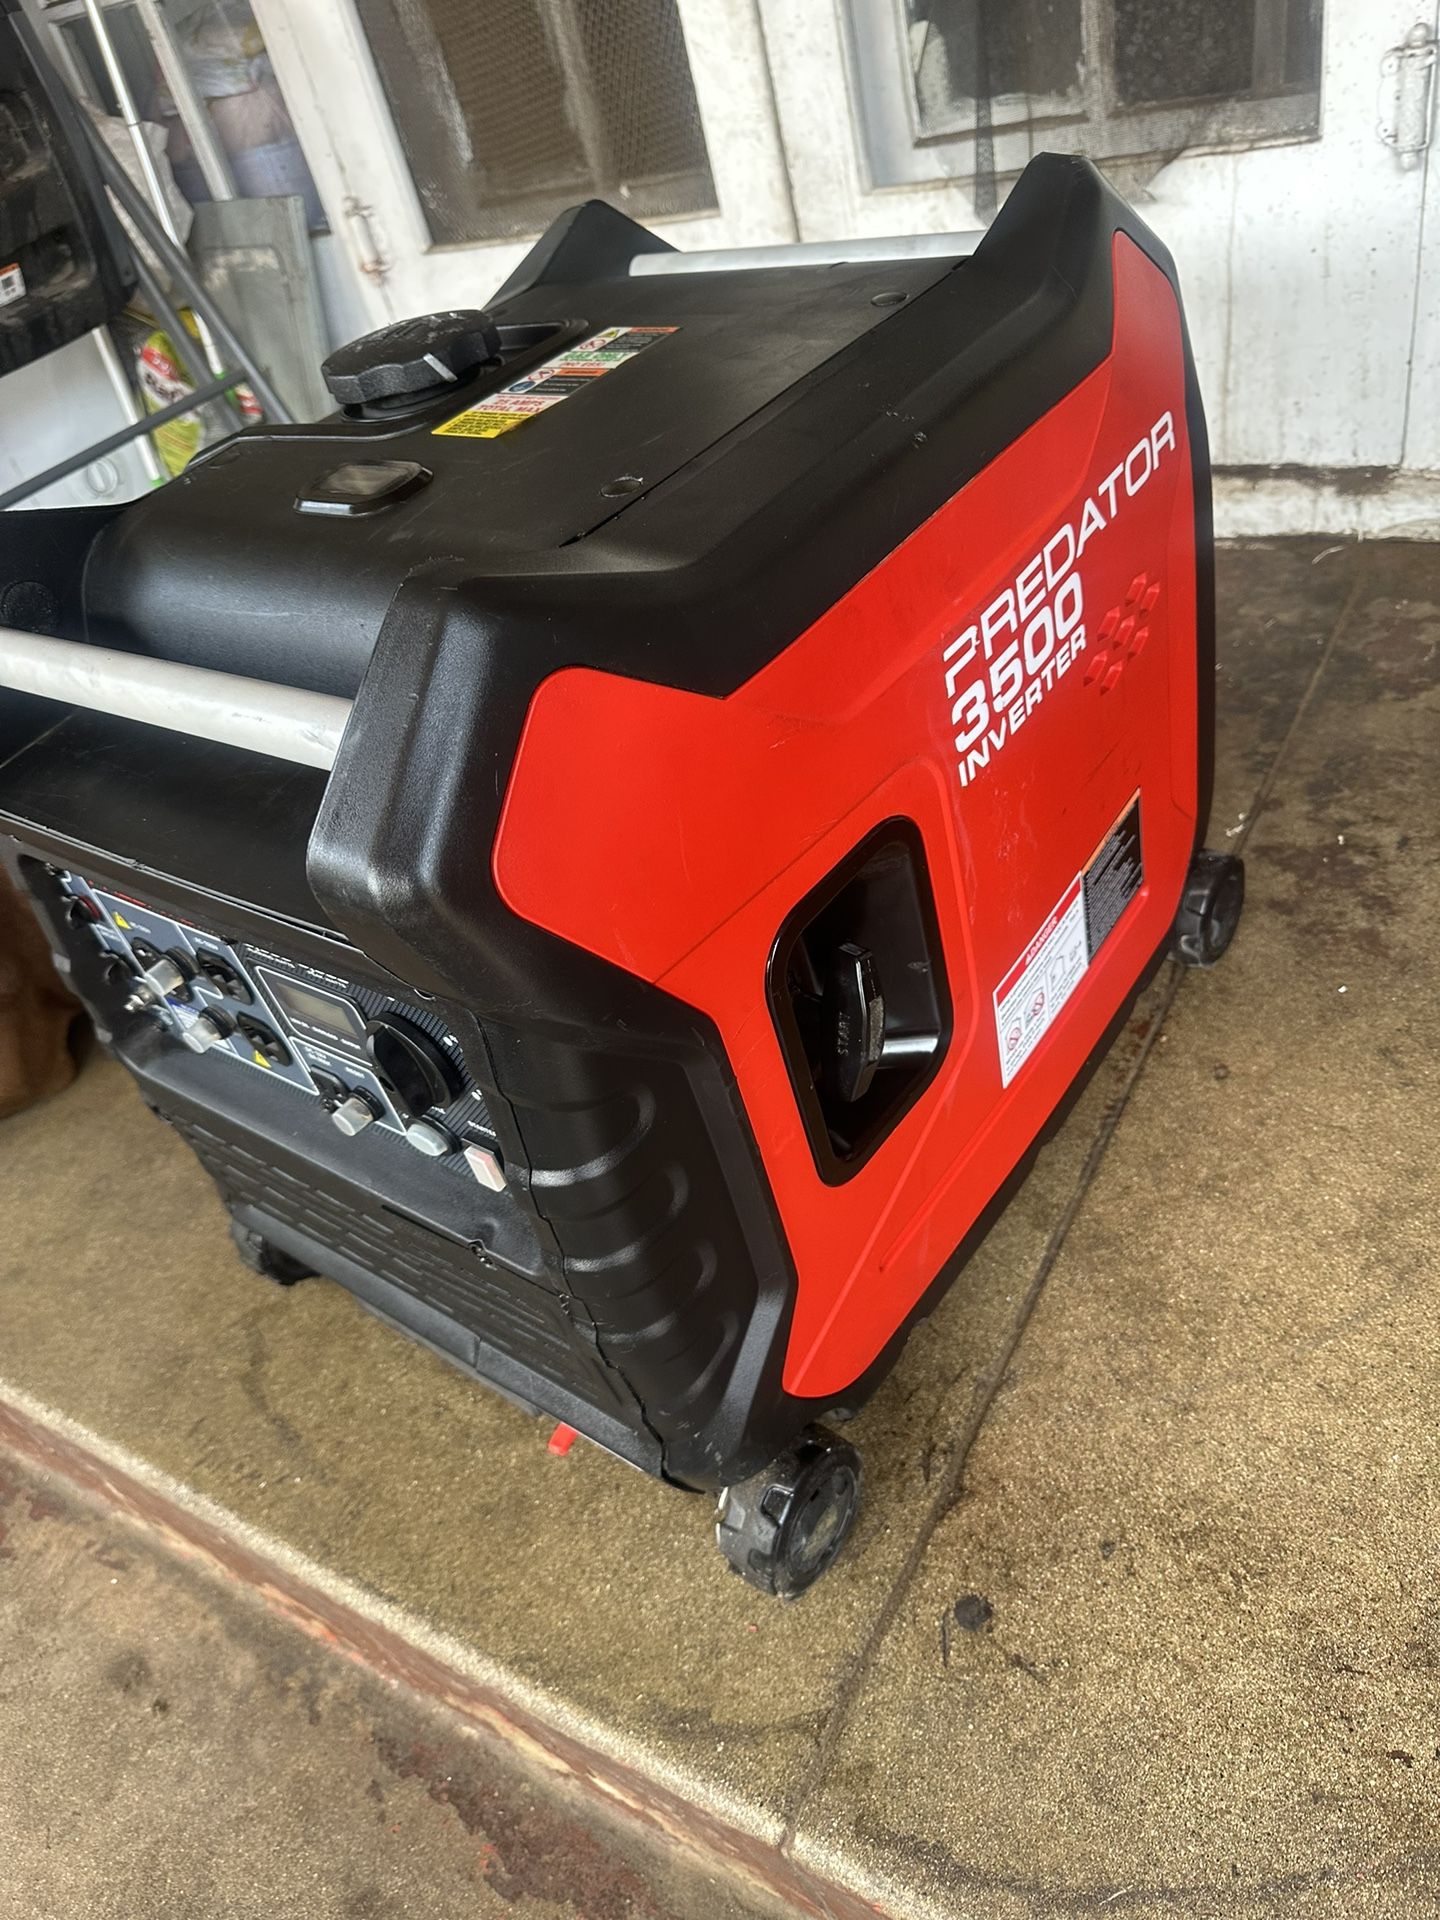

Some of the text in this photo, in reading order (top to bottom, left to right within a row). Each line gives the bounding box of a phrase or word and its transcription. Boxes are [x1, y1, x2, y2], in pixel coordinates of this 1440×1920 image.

[943, 410, 1176, 699] PREDATOR
[952, 571, 1084, 754] 3500
[957, 623, 1087, 787] INVERTER
[1028, 915, 1059, 960] DANGER
[837, 1011, 851, 1057] START
